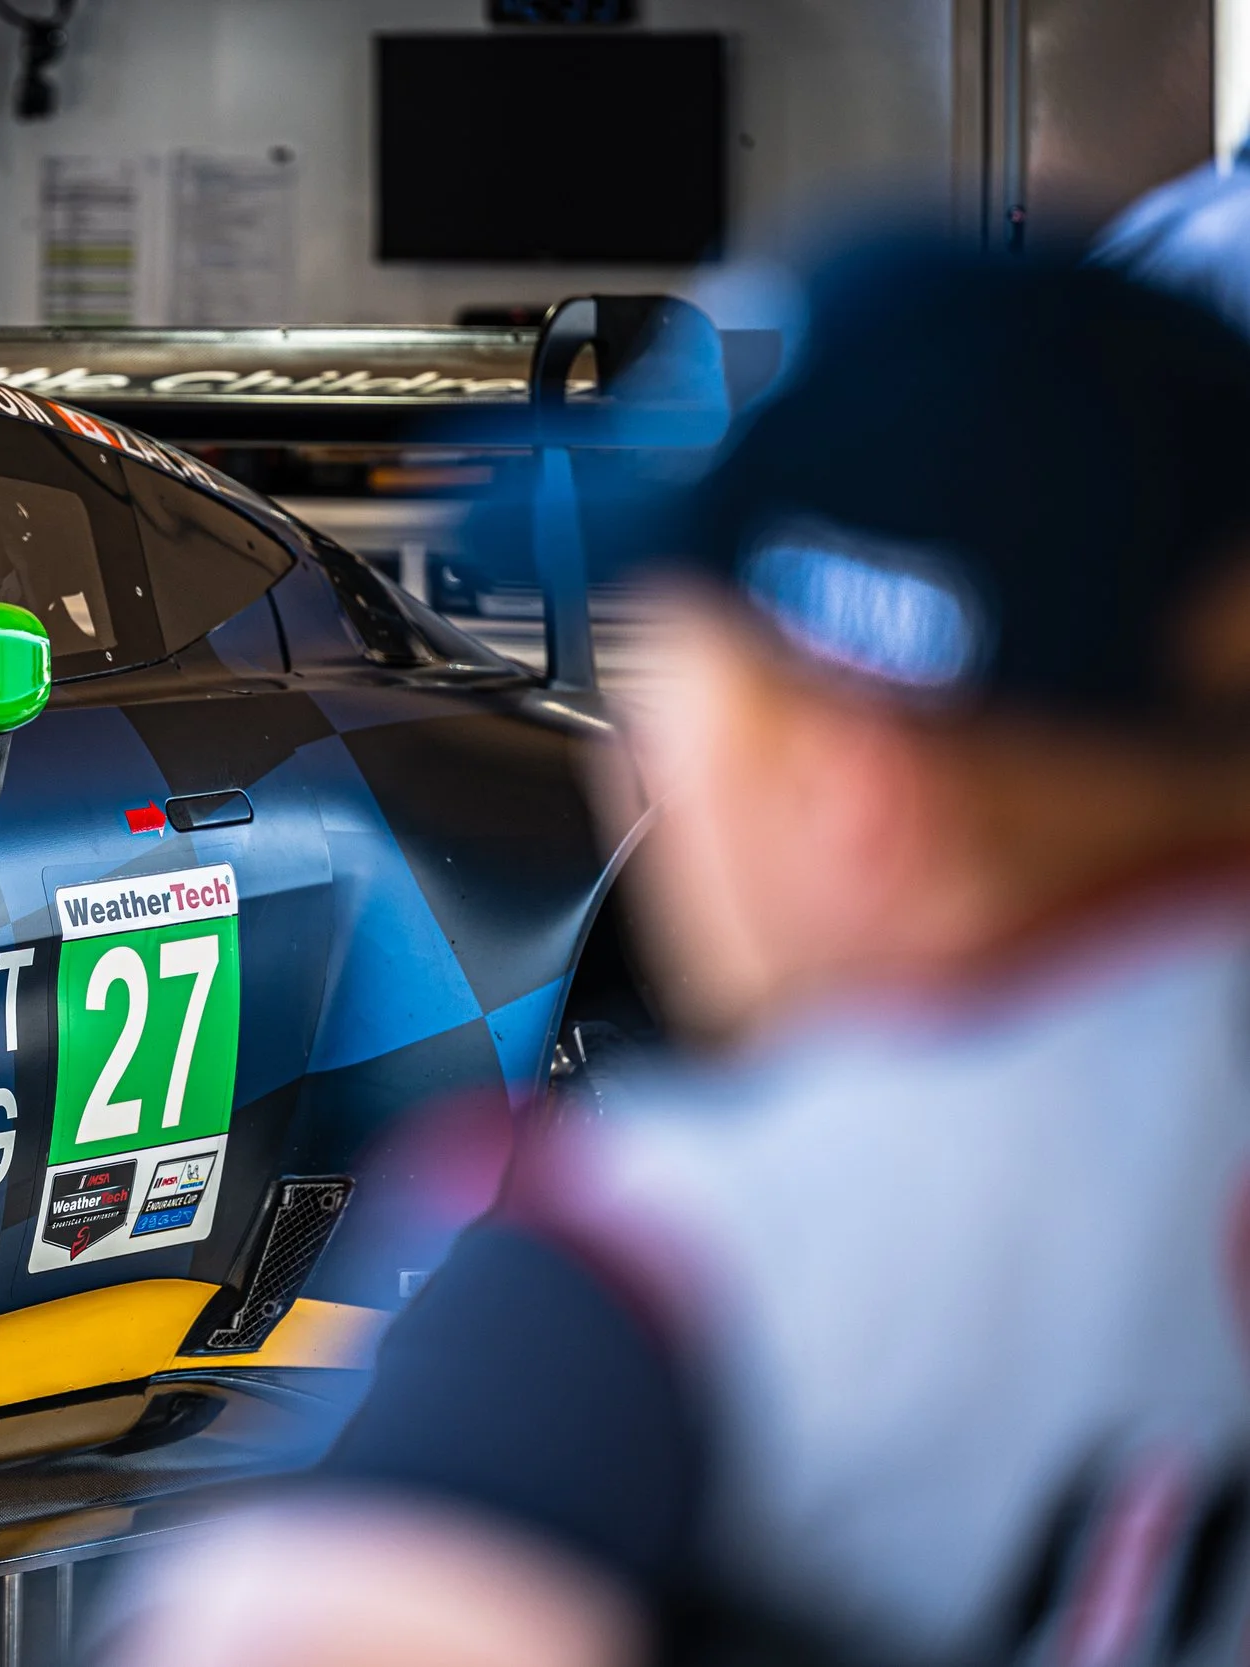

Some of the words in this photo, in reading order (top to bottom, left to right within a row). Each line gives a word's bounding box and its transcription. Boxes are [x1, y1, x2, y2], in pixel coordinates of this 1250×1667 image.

[64, 877, 231, 927] WeatherTech
[75, 934, 220, 1145] 27
[53, 1188, 129, 1214] WeatherTech
